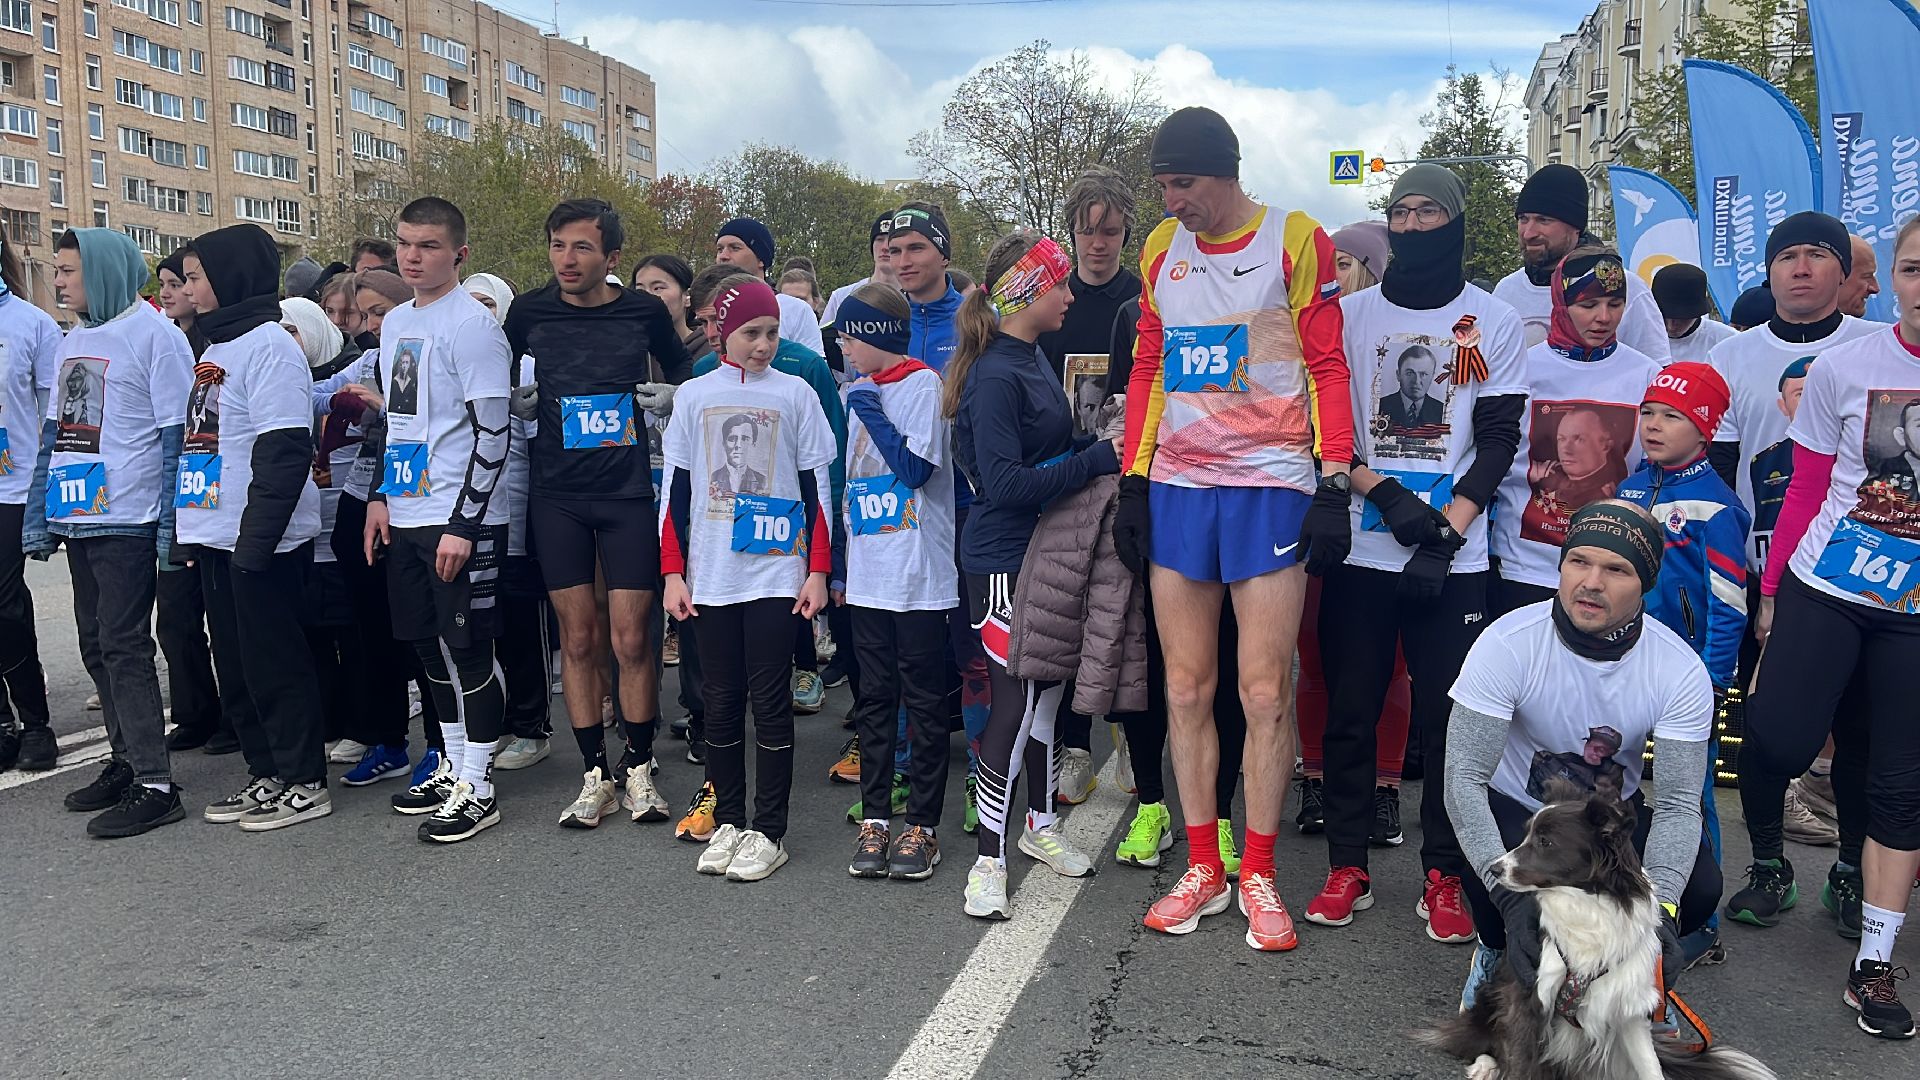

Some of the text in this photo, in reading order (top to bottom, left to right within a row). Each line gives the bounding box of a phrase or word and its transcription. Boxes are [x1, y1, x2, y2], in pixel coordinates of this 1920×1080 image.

[1191, 266, 1207, 274] NN
[845, 319, 903, 335] INOVIK
[1179, 345, 1229, 375] 193
[577, 410, 621, 435] 163
[393, 460, 413, 484] 76
[60, 479, 86, 503] 111
[857, 492, 898, 520] 109
[753, 514, 791, 542] 110
[1848, 545, 1911, 591] 161
